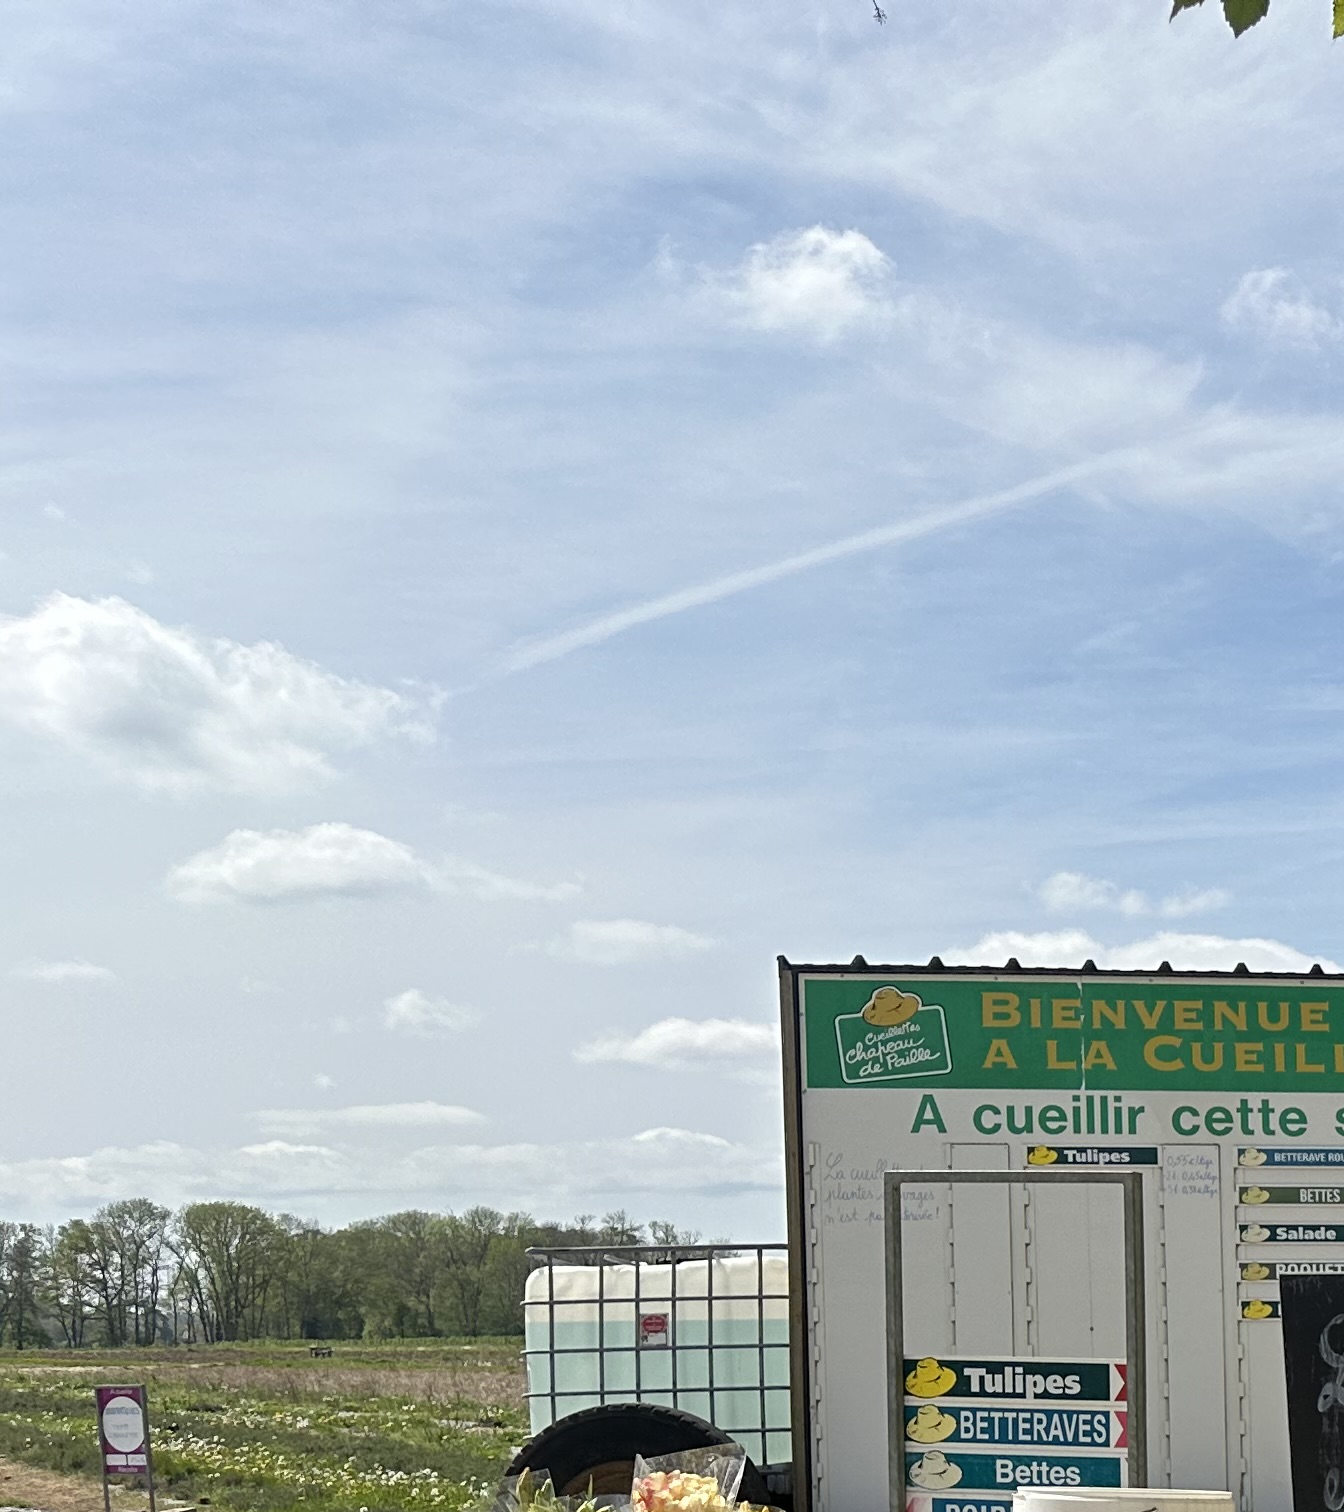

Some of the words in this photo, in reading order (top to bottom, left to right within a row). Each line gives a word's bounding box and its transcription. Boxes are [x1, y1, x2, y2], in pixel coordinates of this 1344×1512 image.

[981, 992, 1330, 1032] BIENVENUE
[865, 1022, 920, 1044] Cueillettes
[859, 1061, 884, 1076] de
[886, 1048, 940, 1070] Paille
[982, 1039, 1018, 1069] A
[1046, 1040, 1117, 1070] LA
[911, 1094, 947, 1133] A
[973, 1095, 1144, 1135] cueillir
[1172, 1099, 1307, 1136] cette
[1064, 1149, 1131, 1164] Tulipes
[1274, 1152, 1326, 1163] BETTERAVE
[1299, 1188, 1341, 1203] BETTES
[1276, 1227, 1337, 1240] Salade
[963, 1366, 1081, 1399] Tulipes
[960, 1411, 1107, 1443] BETTERAVES
[995, 1459, 1081, 1485] Bettes
